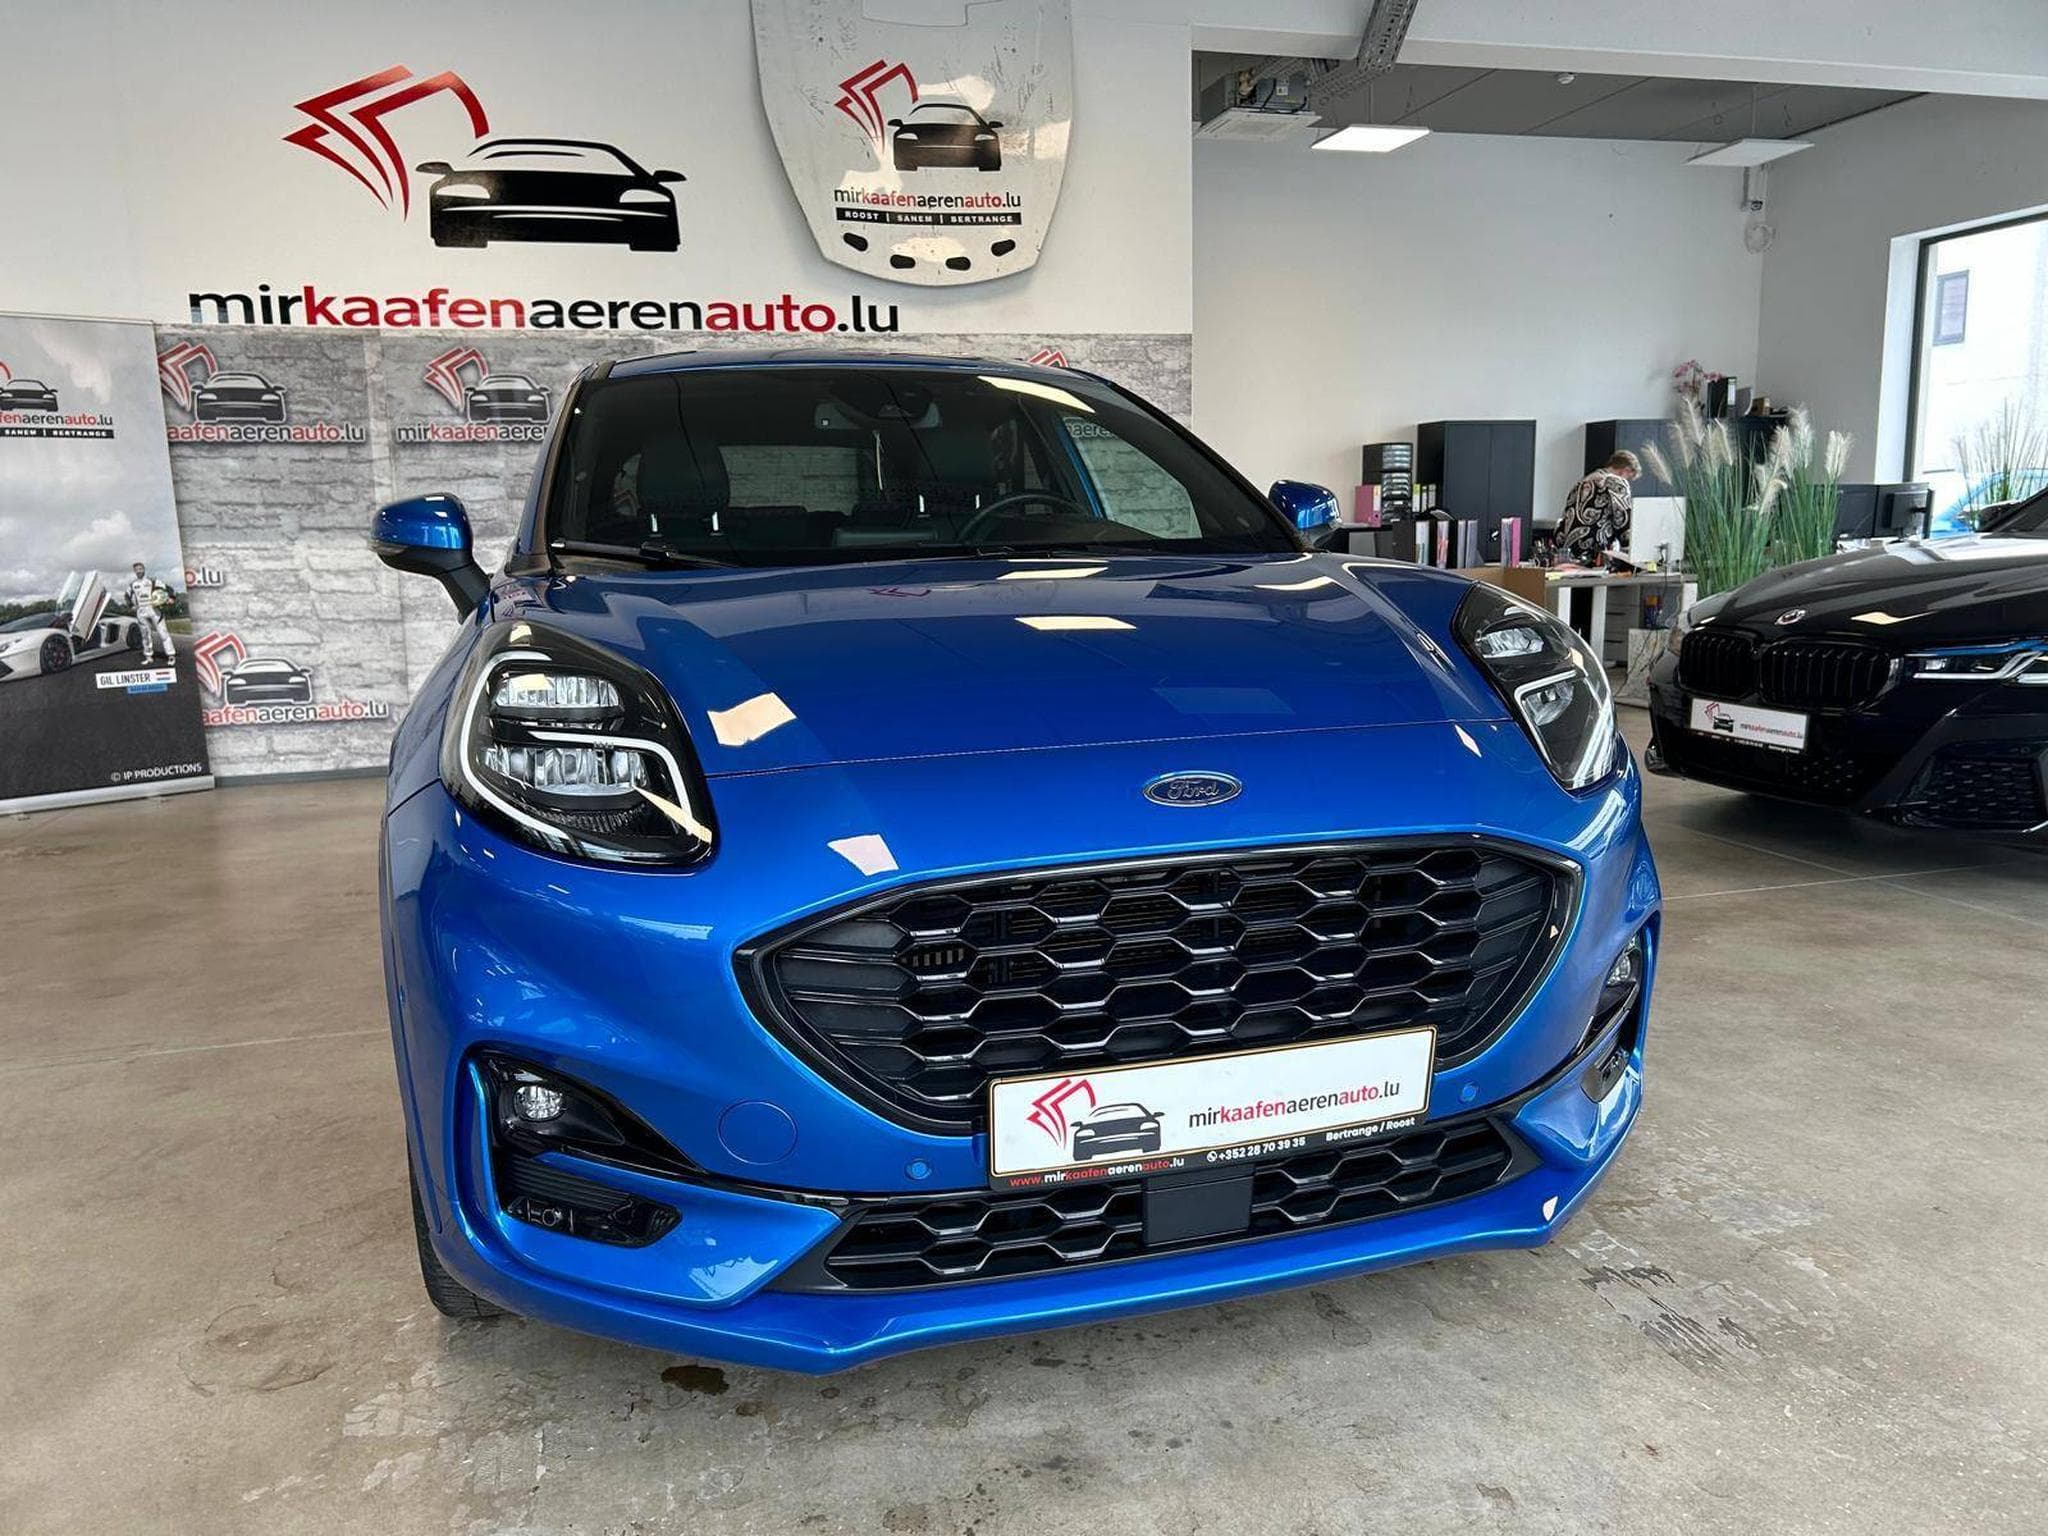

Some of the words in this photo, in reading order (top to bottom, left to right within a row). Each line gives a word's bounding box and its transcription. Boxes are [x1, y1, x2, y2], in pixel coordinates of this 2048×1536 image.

[834, 187, 1022, 209] mirkaafenaerenauto.lu
[844, 211, 880, 220] ROOST
[897, 215, 933, 223] SANEM
[950, 215, 1014, 223] BERTRANGE
[189, 284, 899, 333] mirkaafenaerenauto.lu
[100, 676, 114, 685] GIL
[116, 673, 151, 685] LINSTER
[123, 771, 133, 780] IP
[135, 763, 202, 779] PRODUCTIONS
[1167, 779, 1219, 800] Ford
[1188, 1081, 1400, 1128] mirkaafenaerenauto.lu
[1325, 1125, 1379, 1143] Bertrange
[1386, 1116, 1415, 1130] Roost
[1218, 1148, 1246, 1161] +352
[1247, 1145, 1261, 1156] 28
[1262, 1142, 1276, 1153] 70
[1277, 1139, 1291, 1150] 39
[1009, 1157, 1185, 1187] www.mirkaafenaerenauto.lu
